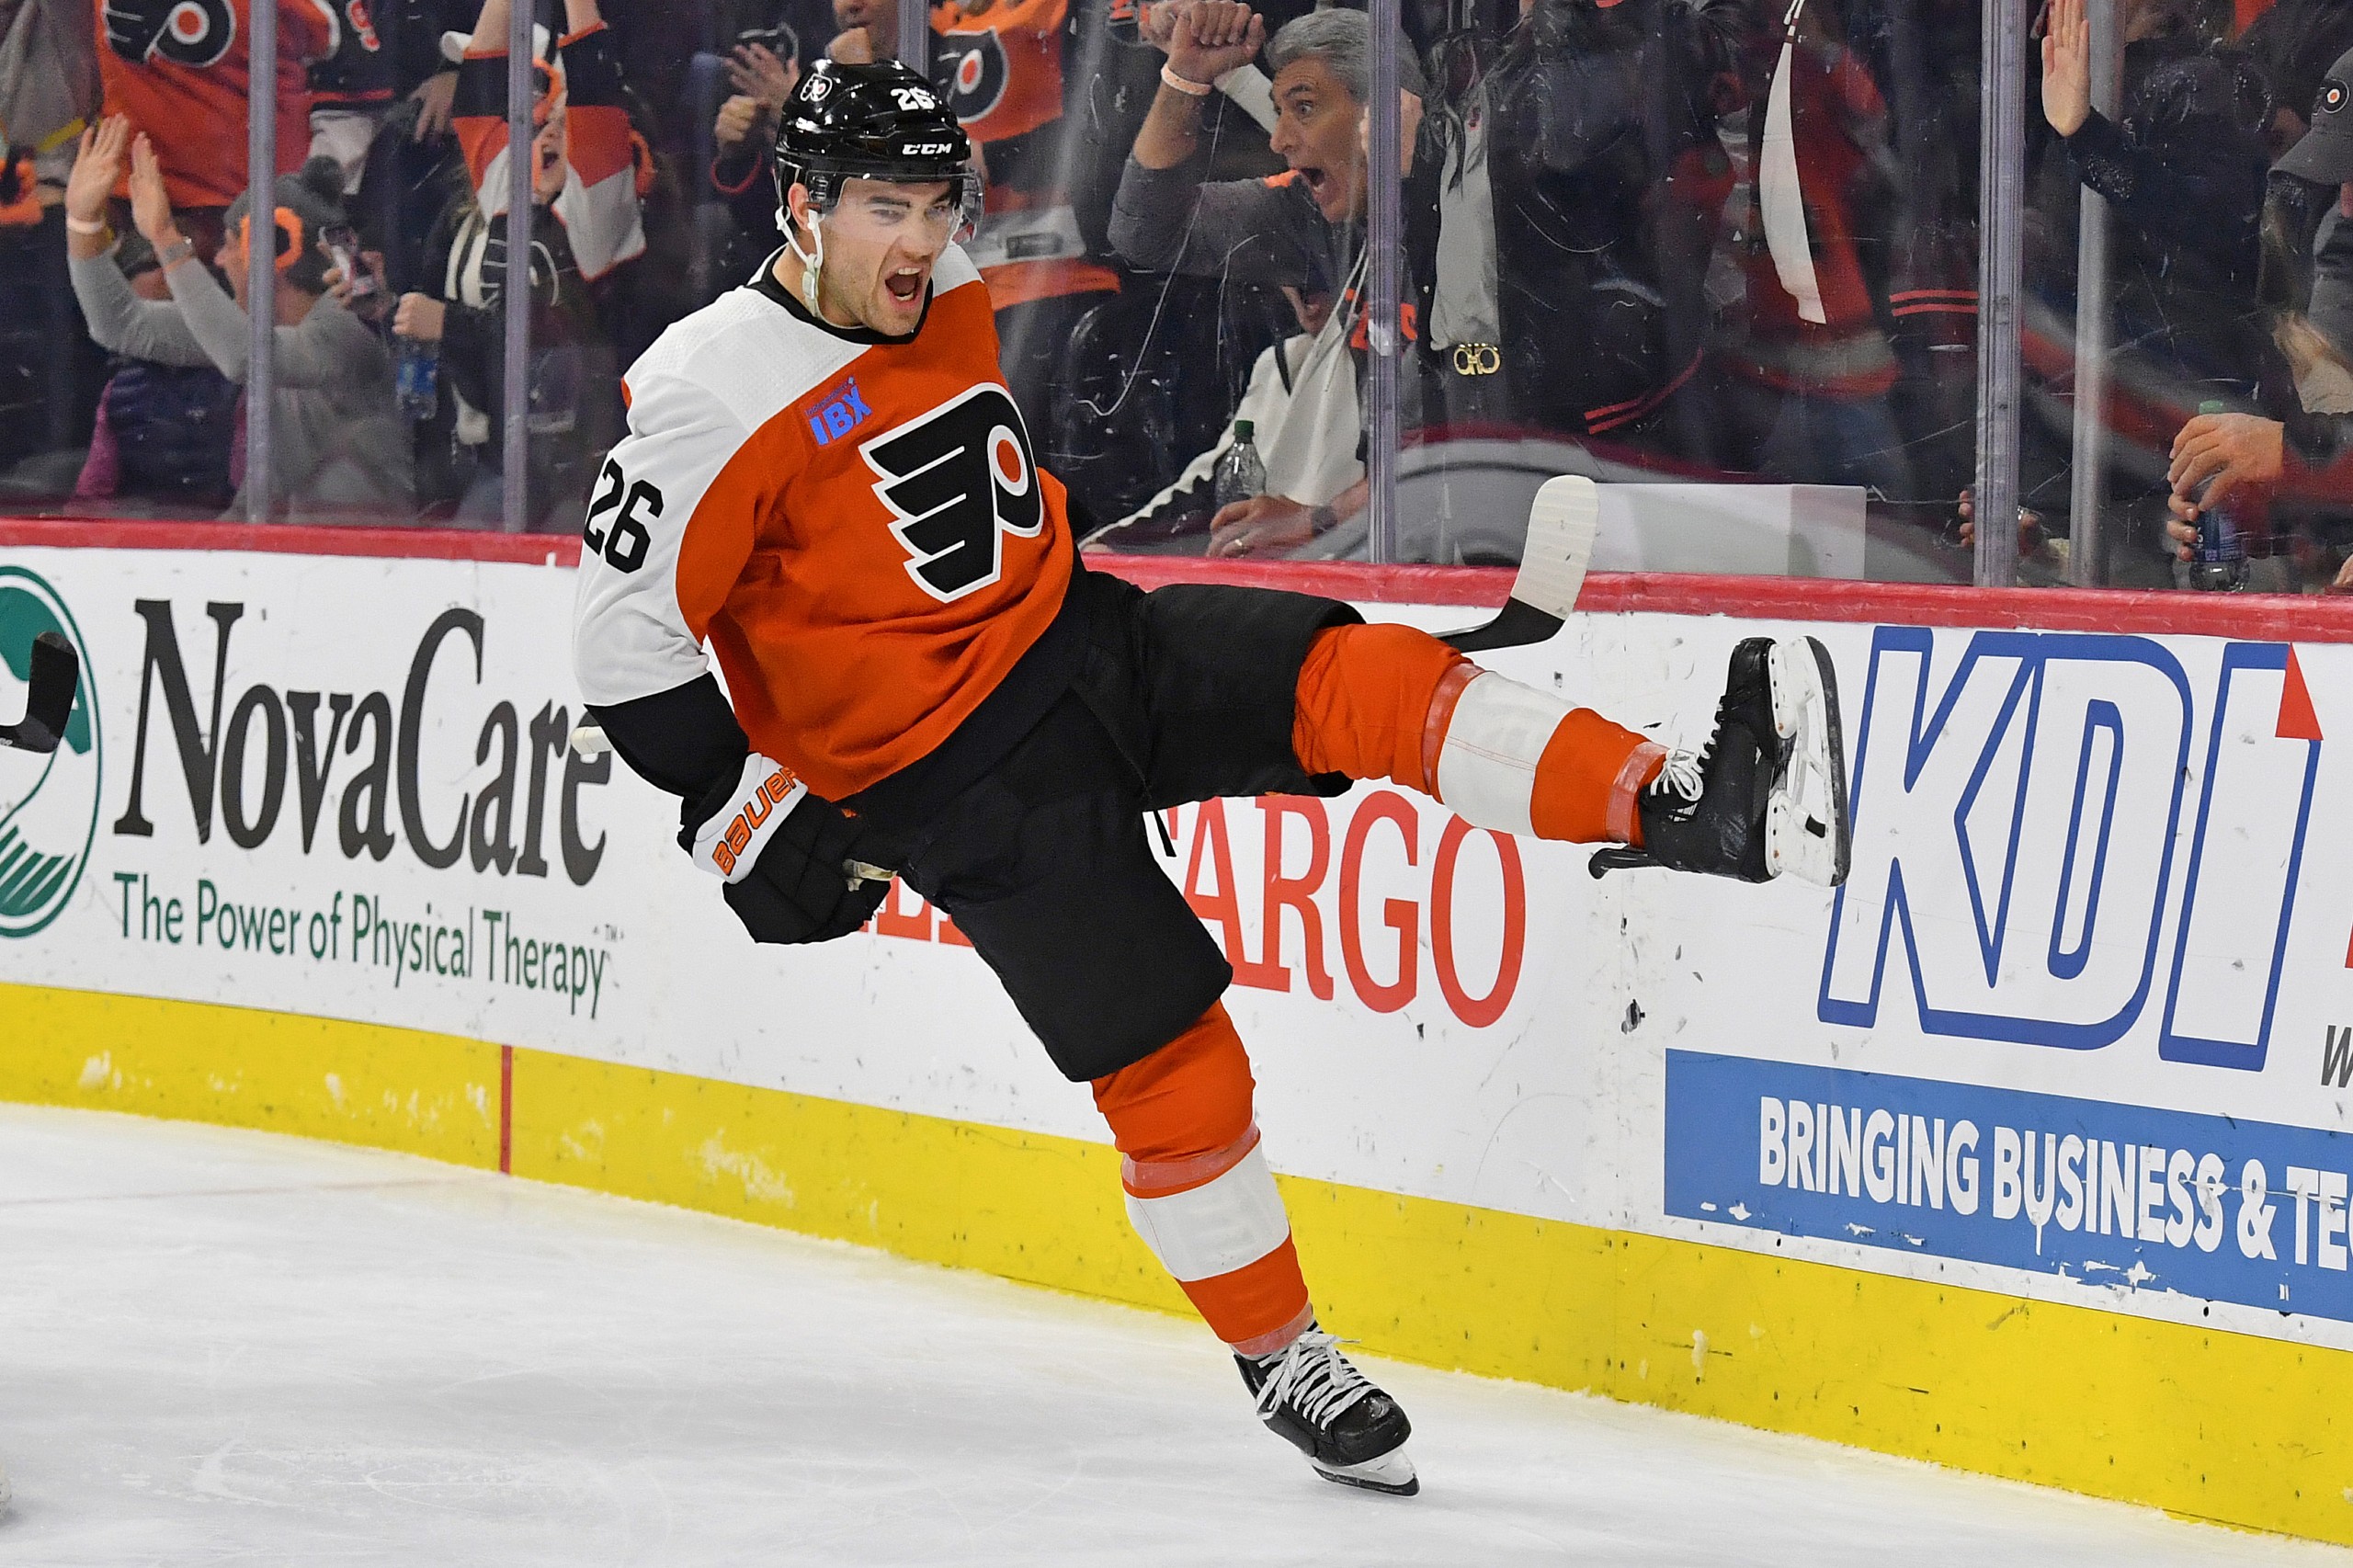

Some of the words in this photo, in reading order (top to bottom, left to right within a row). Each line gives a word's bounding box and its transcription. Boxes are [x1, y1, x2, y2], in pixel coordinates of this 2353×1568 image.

[890, 86, 936, 111] 26
[902, 142, 952, 155] CCM
[810, 384, 872, 446] IBX
[584, 457, 665, 574] 26
[113, 598, 612, 887] NovaCare
[1165, 790, 1526, 1028] ARGO
[1817, 625, 2324, 1072] KDI
[113, 871, 183, 944] The
[197, 880, 301, 955] Power
[309, 891, 342, 960] of
[352, 893, 474, 988] Physical
[483, 909, 607, 1019] Therapy
[1759, 1096, 1980, 1215] BRINGING
[1993, 1127, 2225, 1253] BUSINESS
[2237, 1158, 2278, 1260] &
[2286, 1165, 2353, 1271] TE
